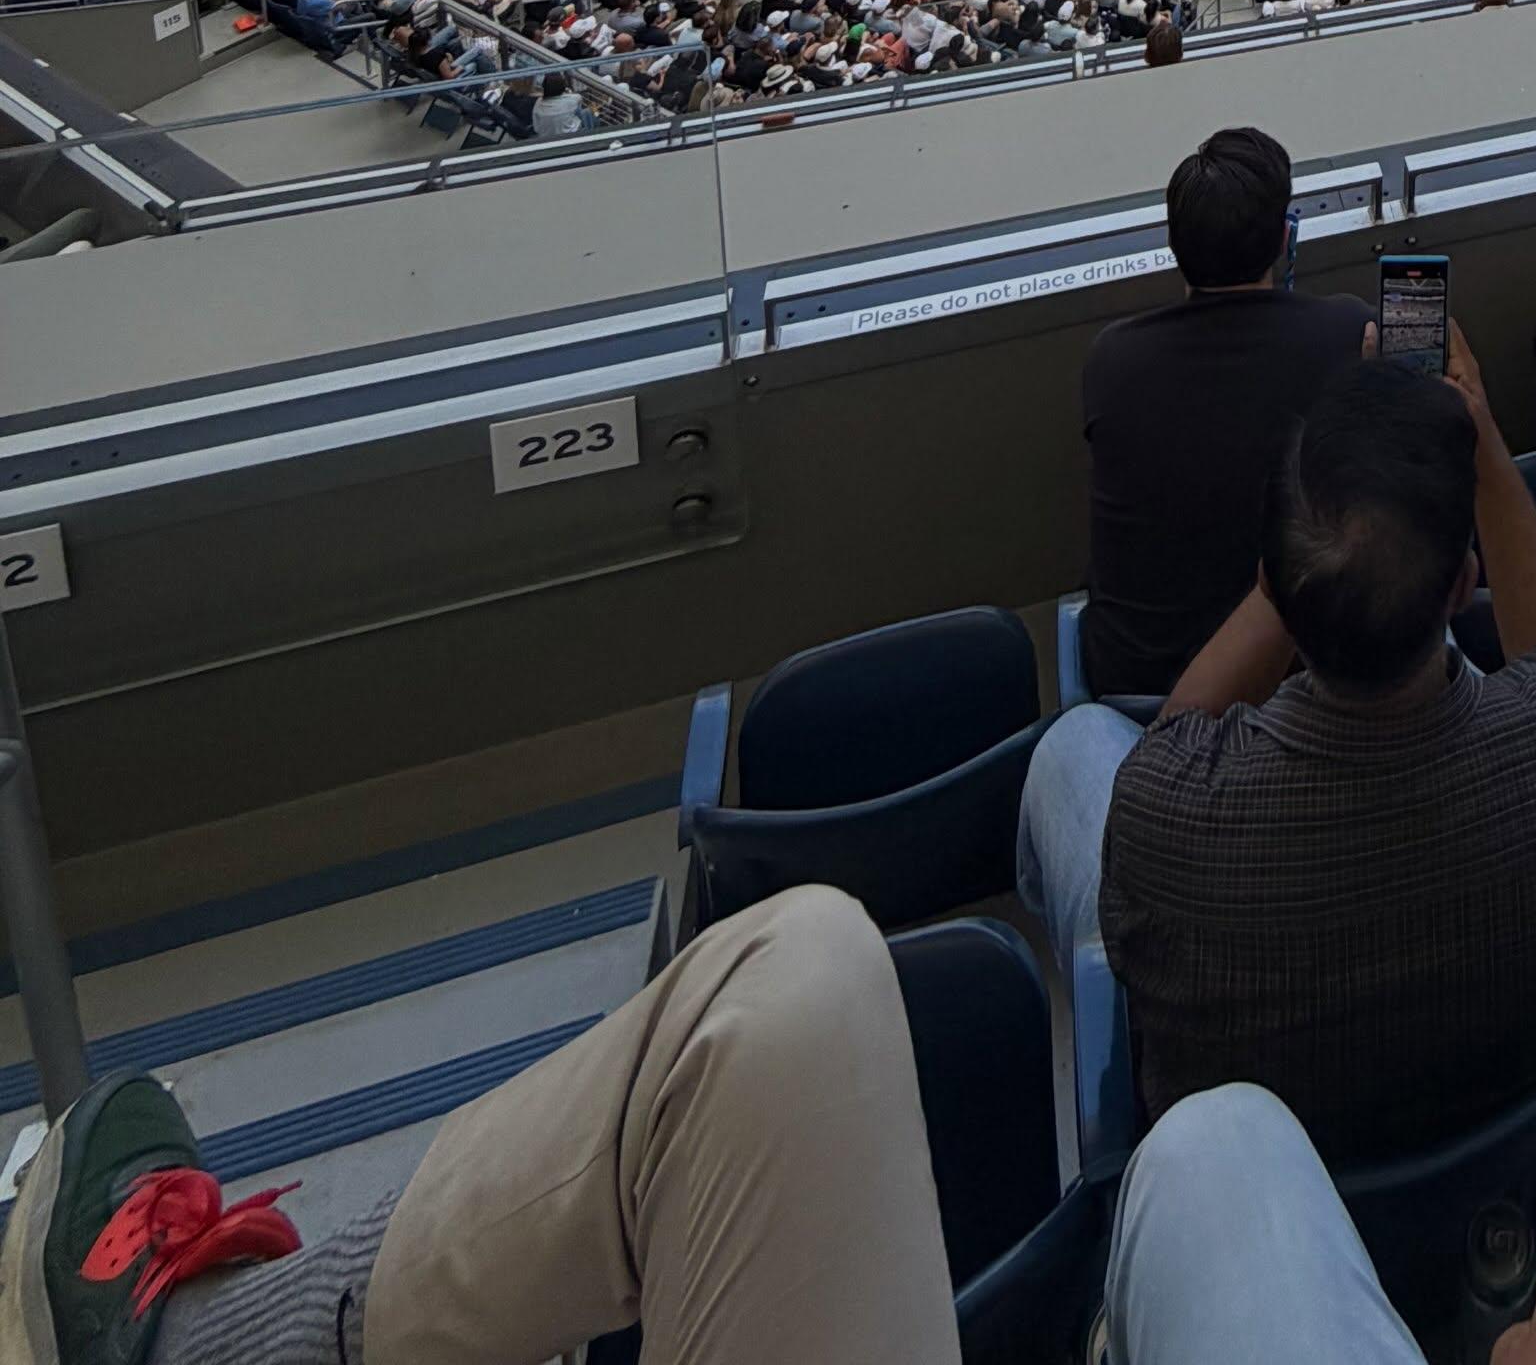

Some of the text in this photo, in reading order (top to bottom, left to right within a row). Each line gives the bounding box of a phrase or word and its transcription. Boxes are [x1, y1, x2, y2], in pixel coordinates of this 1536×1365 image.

[857, 302, 933, 330] Please
[940, 294, 968, 312] do
[975, 284, 1011, 305] not
[1018, 271, 1075, 299] place
[1082, 255, 1147, 281] drinks
[518, 422, 615, 469] 223
